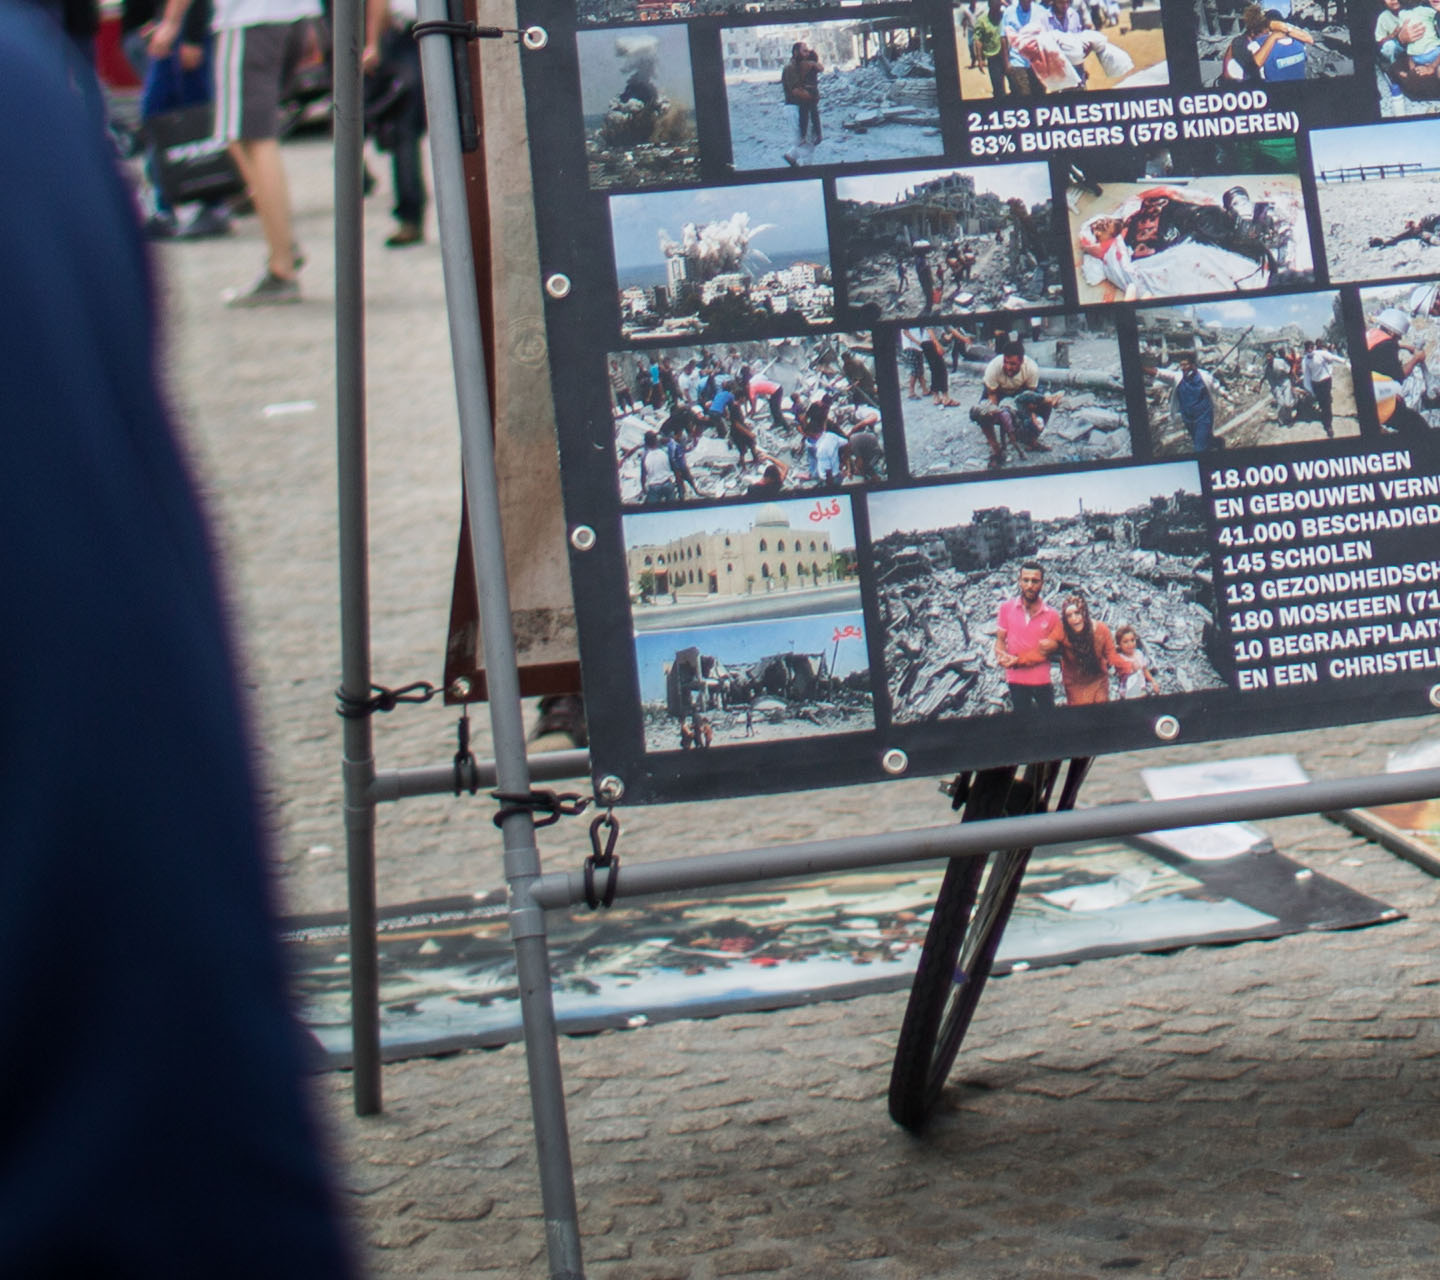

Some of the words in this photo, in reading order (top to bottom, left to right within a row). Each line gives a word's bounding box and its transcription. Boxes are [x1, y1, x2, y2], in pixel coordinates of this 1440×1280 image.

[968, 109, 1030, 132] 2.153
[1036, 98, 1173, 127] PALESTIJNEN
[1179, 91, 1268, 114] GEDOOD
[970, 133, 1016, 156] 83%
[1021, 125, 1124, 152] BURGERS
[1130, 121, 1178, 147] (578
[1183, 111, 1299, 138] KINDEREN)
[1211, 464, 1288, 490] 18.000
[1293, 451, 1411, 481] WONINGEN
[809, 499, 841, 522] قبل
[1215, 498, 1244, 519] EN
[1250, 483, 1376, 515] GEBOUWEN
[1218, 521, 1296, 546] 41.000
[1222, 553, 1266, 575] 145
[1271, 541, 1373, 570] SCHOLEN
[1226, 583, 1255, 604] 13
[1230, 609, 1273, 632] 180
[1279, 594, 1401, 626] MOSKEEEN
[1234, 640, 1262, 661] 10
[1238, 668, 1268, 690] EN
[1274, 662, 1318, 686] EEN
